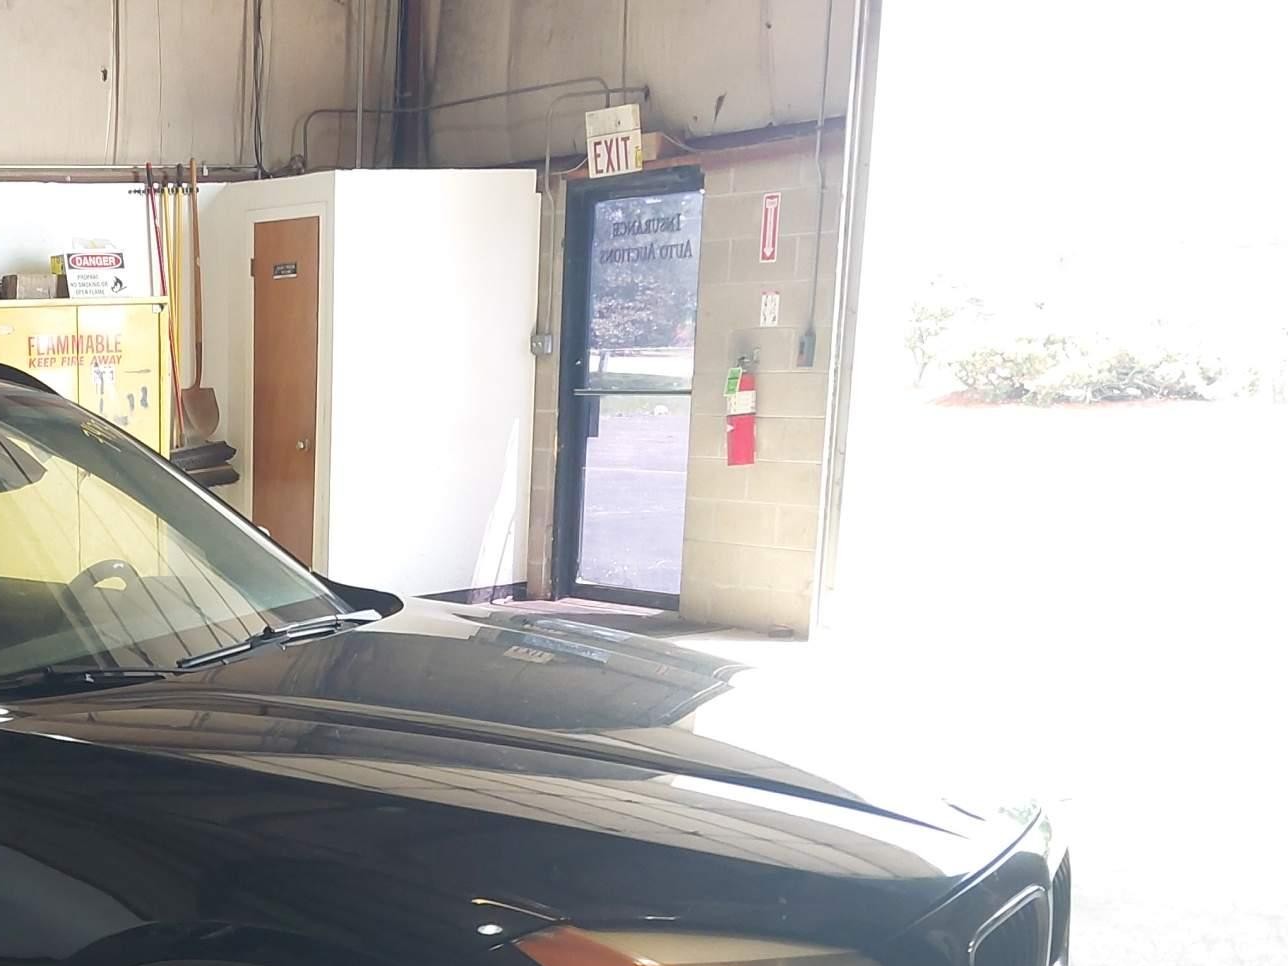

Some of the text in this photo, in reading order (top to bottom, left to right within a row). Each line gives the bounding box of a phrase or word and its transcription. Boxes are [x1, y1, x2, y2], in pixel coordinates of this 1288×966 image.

[593, 136, 630, 174] EXIT
[75, 256, 116, 267] DANGER
[27, 334, 123, 356] FLAMMABLE
[28, 355, 123, 369] KEEP FIRE AWAY
